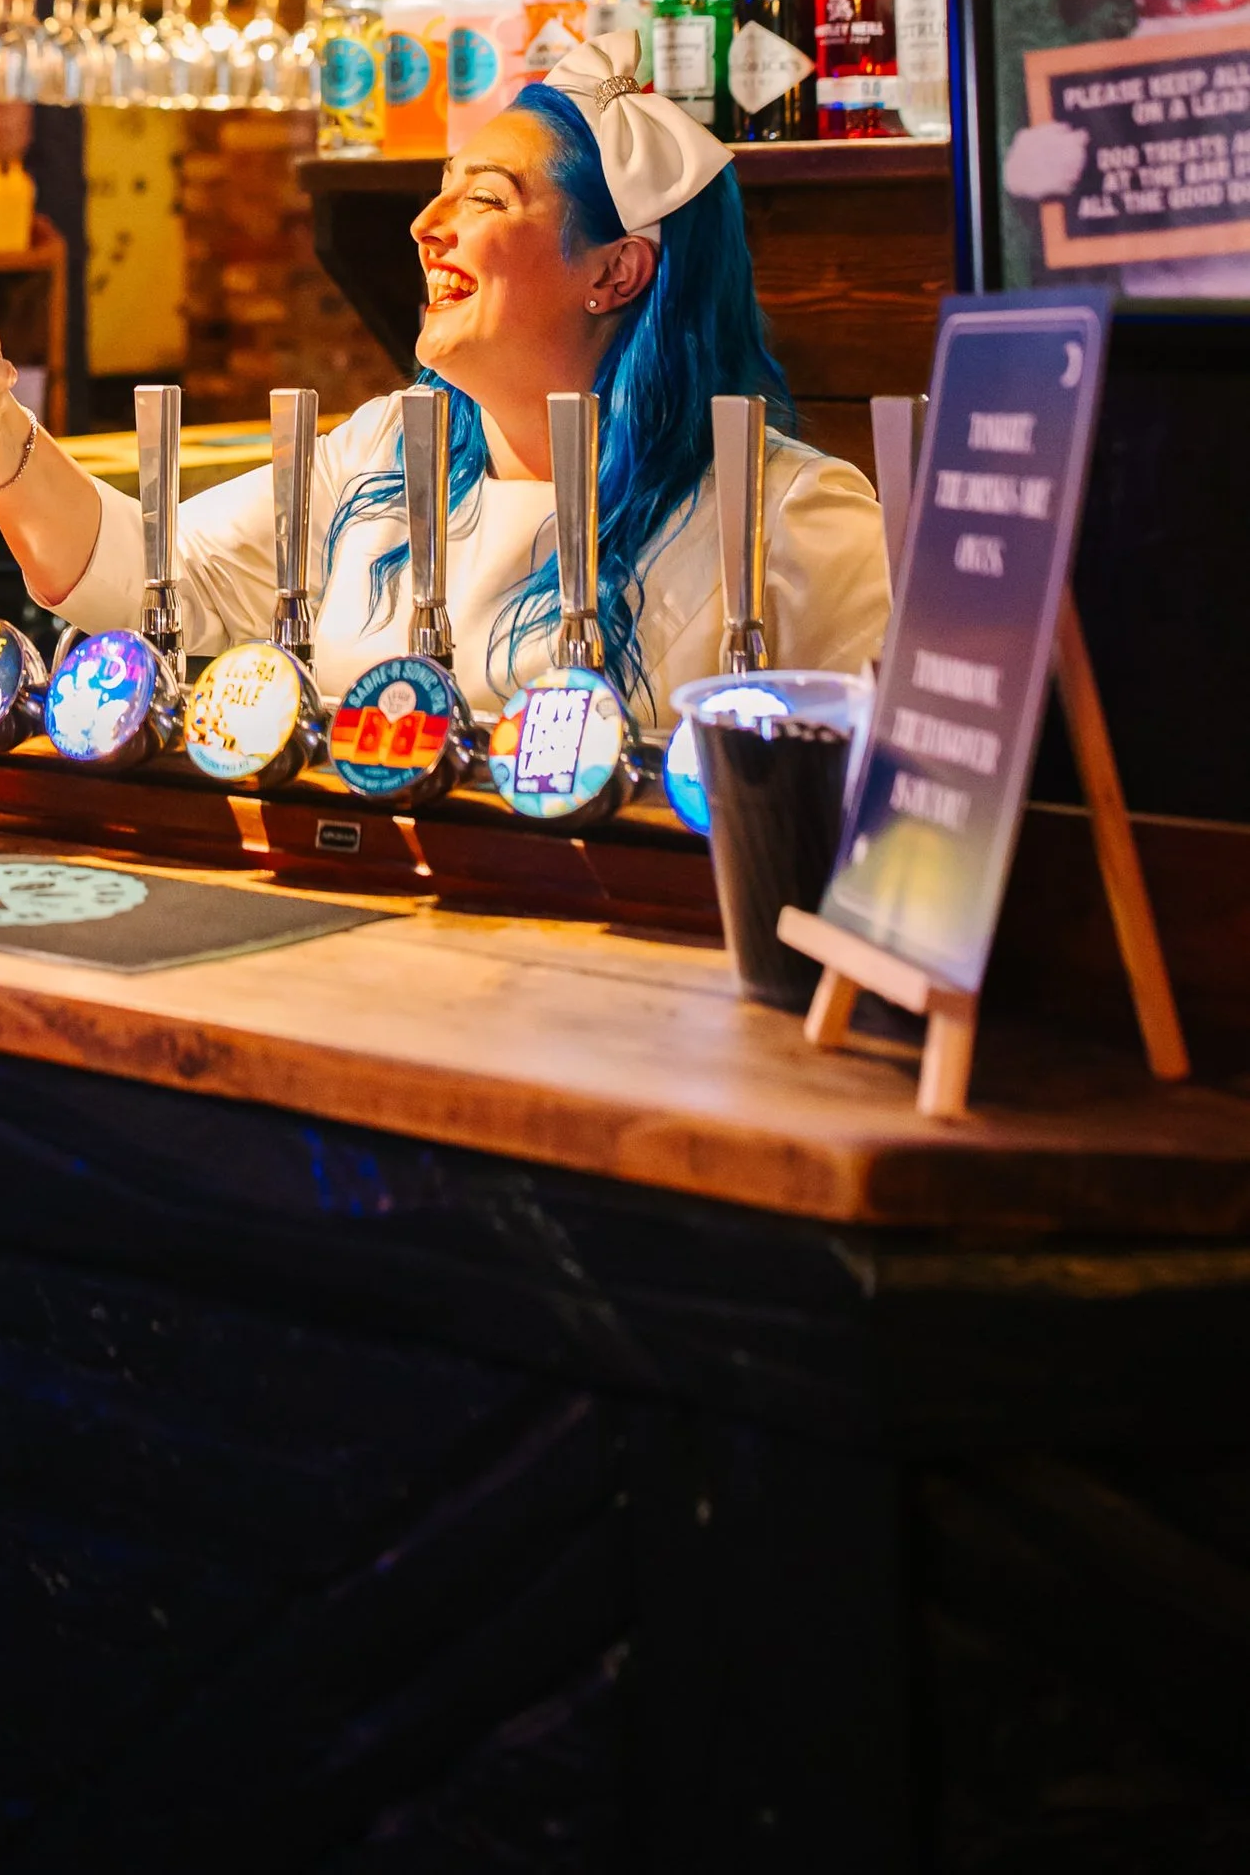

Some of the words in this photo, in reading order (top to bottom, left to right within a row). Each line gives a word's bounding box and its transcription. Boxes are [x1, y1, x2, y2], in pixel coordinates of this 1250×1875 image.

[1063, 78, 1145, 111] PLEASE
[1168, 97, 1188, 122] A
[1137, 165, 1181, 189] THE
[1078, 193, 1120, 219] ALL
[402, 661, 438, 691] SONIC
[222, 683, 265, 706] PALE
